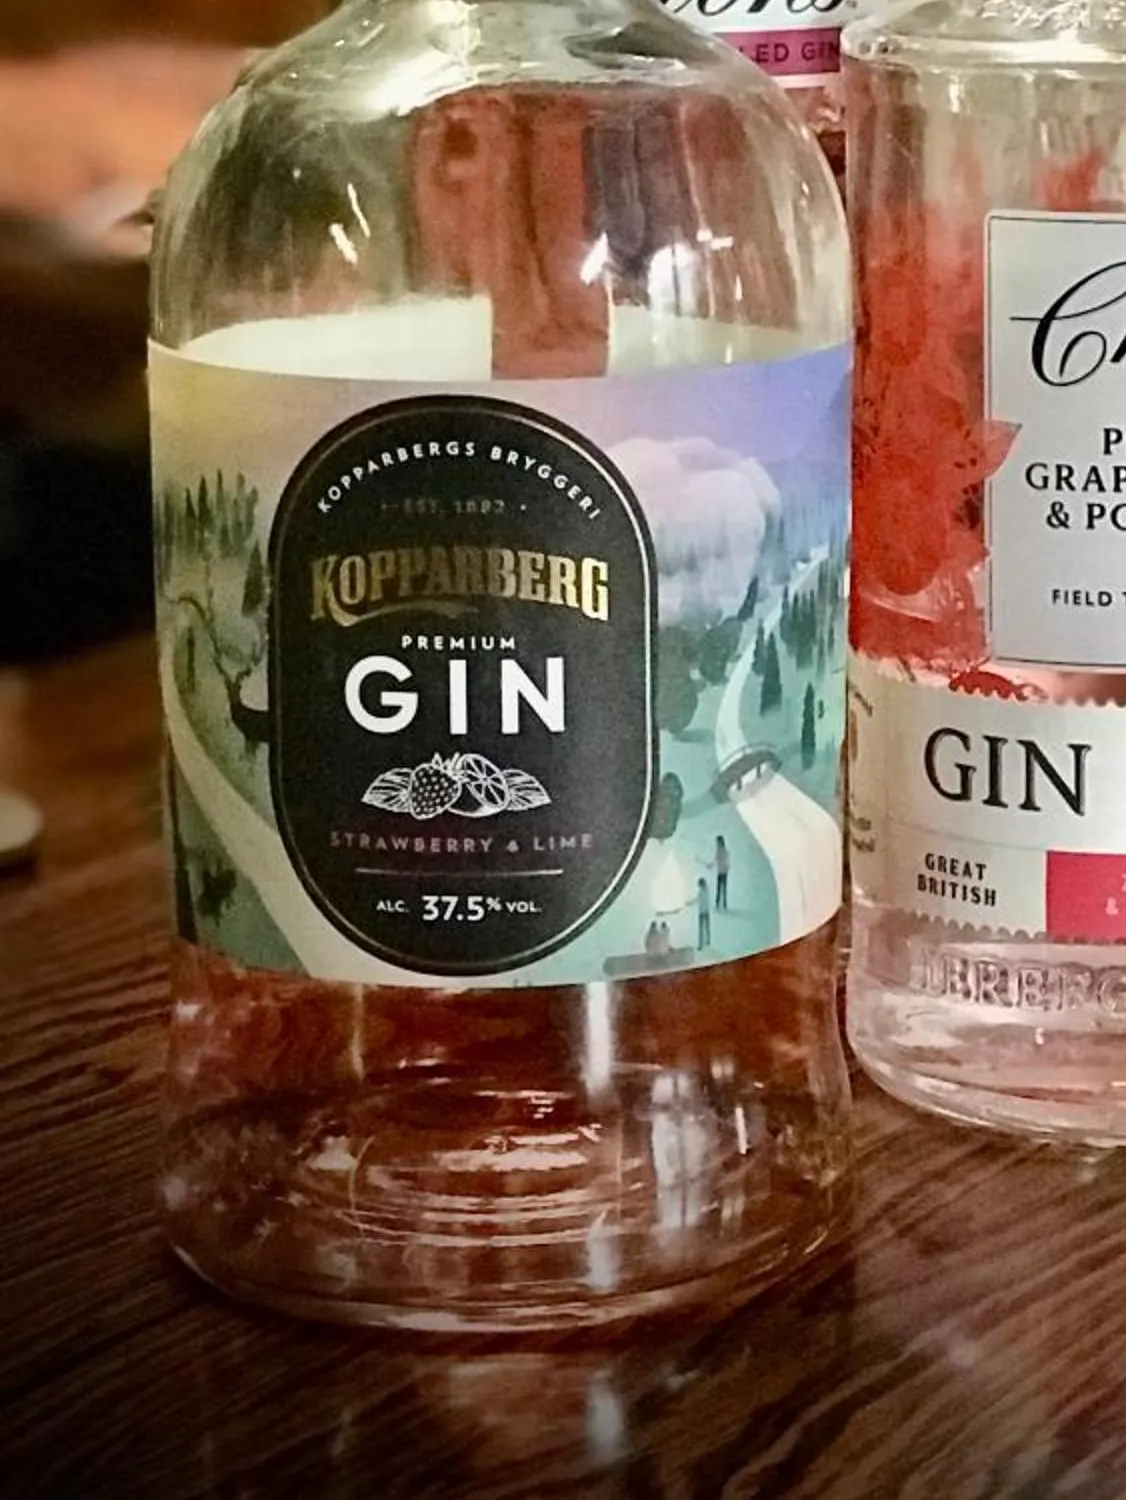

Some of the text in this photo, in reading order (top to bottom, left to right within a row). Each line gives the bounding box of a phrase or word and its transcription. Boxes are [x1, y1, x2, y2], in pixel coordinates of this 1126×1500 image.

[317, 440, 602, 521] KOPPARBERGS BRYGGERI
[1046, 501, 1071, 530] &
[310, 543, 610, 627] KOPPARBERG
[1051, 589, 1113, 607] FIELD
[400, 634, 518, 652] PREMIUM
[343, 654, 566, 736] GIN
[923, 726, 1093, 817] GIN
[330, 832, 493, 854] STRAWBERRY
[533, 833, 595, 852] LIME
[924, 852, 988, 881] GREAT
[916, 873, 998, 908] BRITISH
[375, 895, 543, 922] ALC. 37.5% VOL.
[1104, 897, 1120, 916] &
